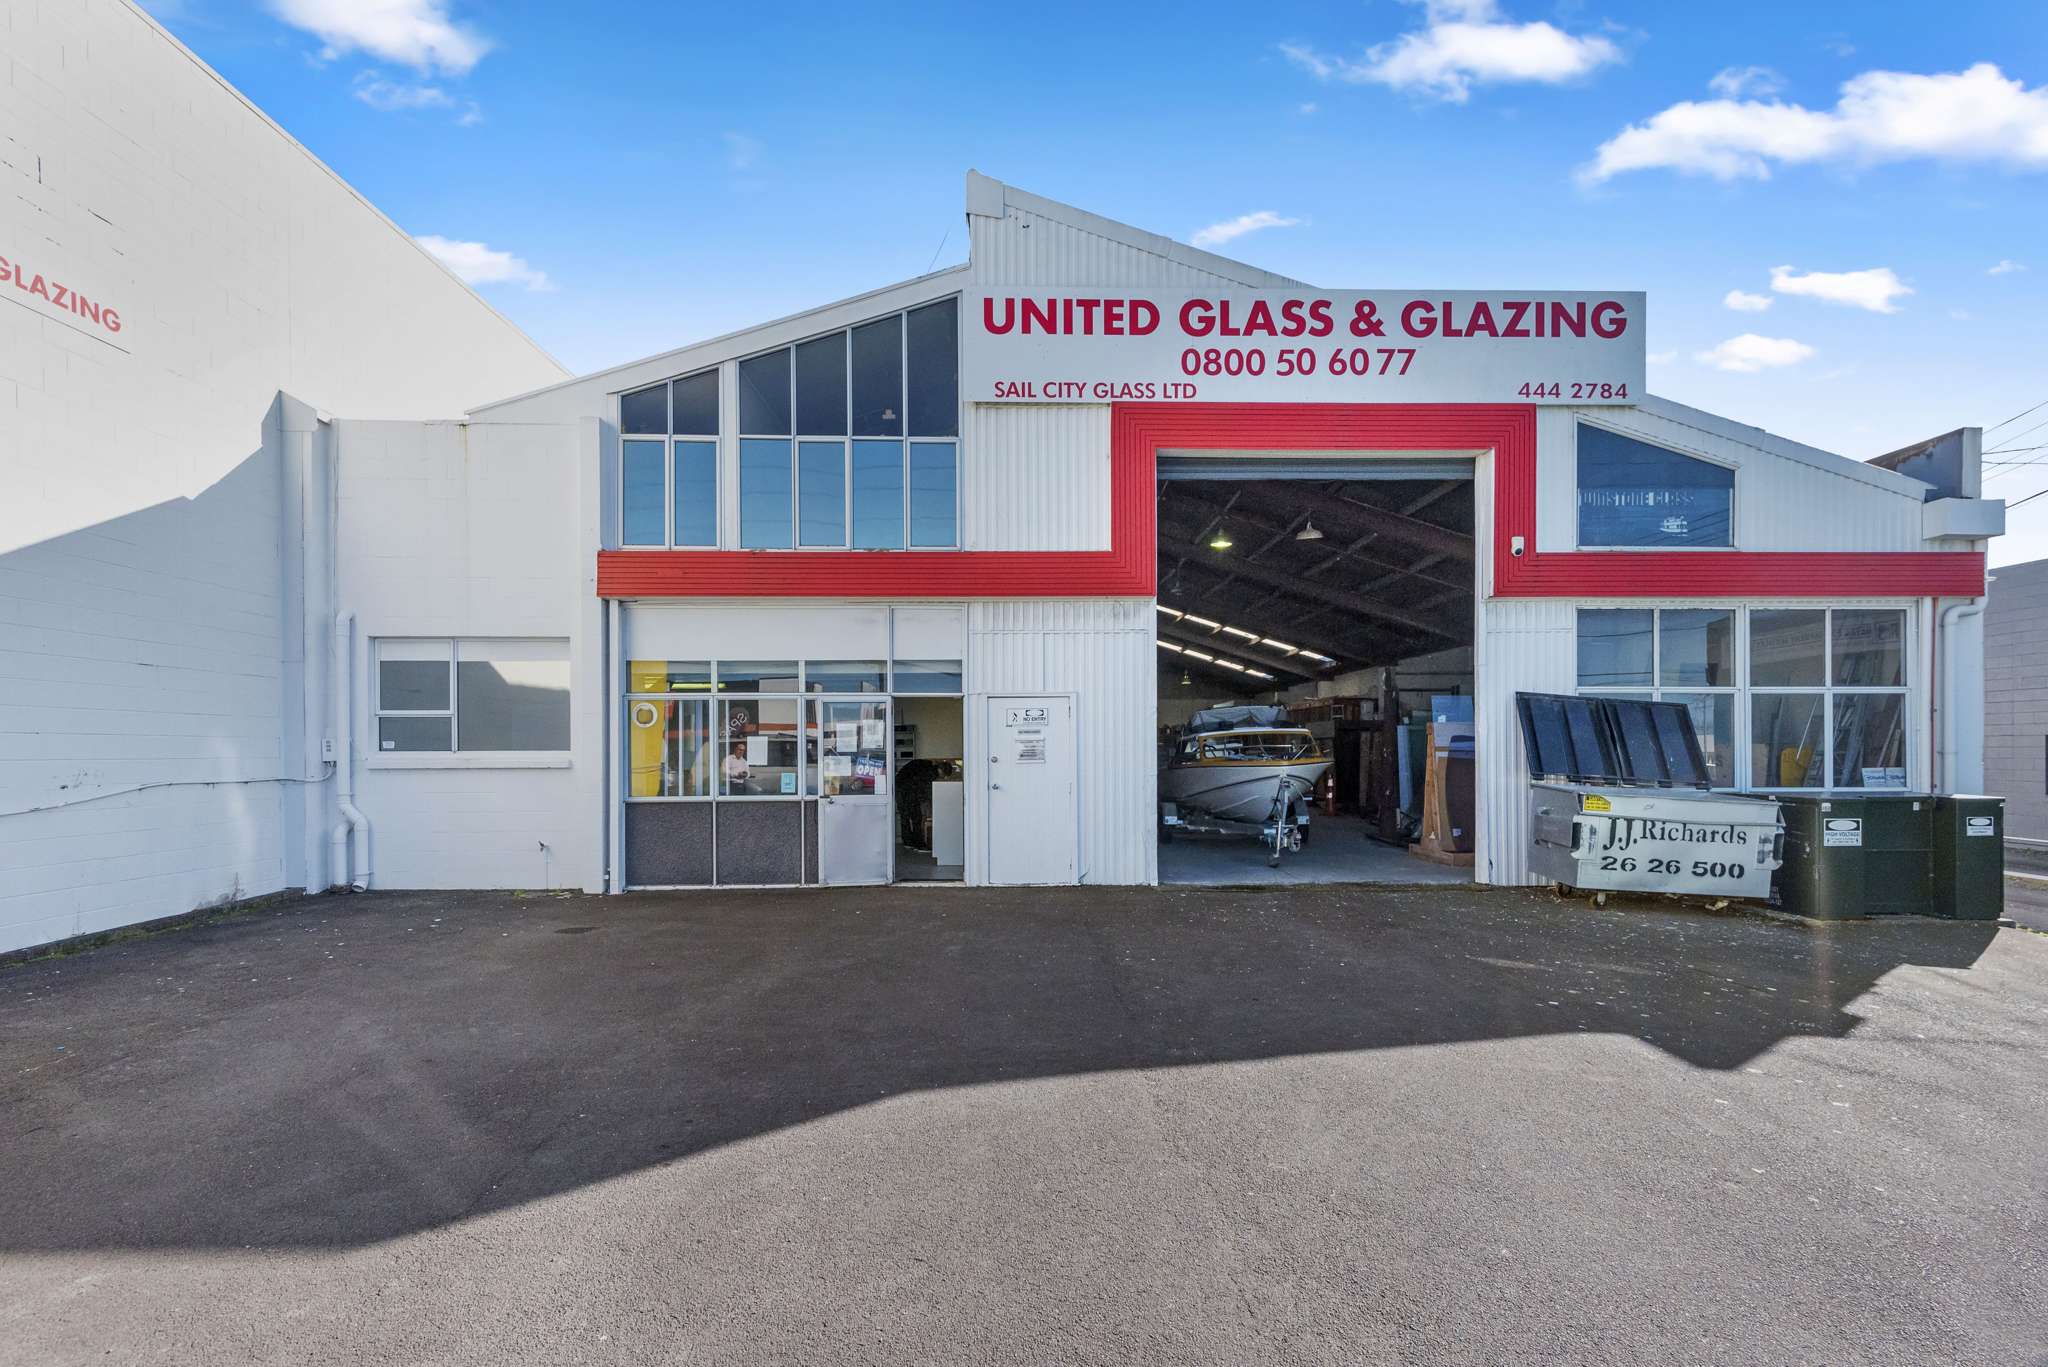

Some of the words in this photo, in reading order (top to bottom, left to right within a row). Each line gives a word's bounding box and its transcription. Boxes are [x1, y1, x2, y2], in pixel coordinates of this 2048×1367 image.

[983, 298, 1160, 336] UNITED
[1178, 299, 1334, 338] GLASS
[1349, 300, 1385, 337] &
[1401, 300, 1627, 339] GLAZING
[1180, 348, 1266, 377] 0800
[1276, 347, 1317, 377] 50
[994, 381, 1037, 398] SAIL
[1042, 382, 1087, 399] CITY
[1093, 382, 1156, 399] GLASS
[1163, 383, 1197, 399] LTD
[1518, 382, 1561, 399] 444
[1570, 382, 1628, 399] 2784
[1600, 855, 1637, 873] 26
[1647, 858, 1681, 875] 26
[1691, 861, 1745, 880] 500
